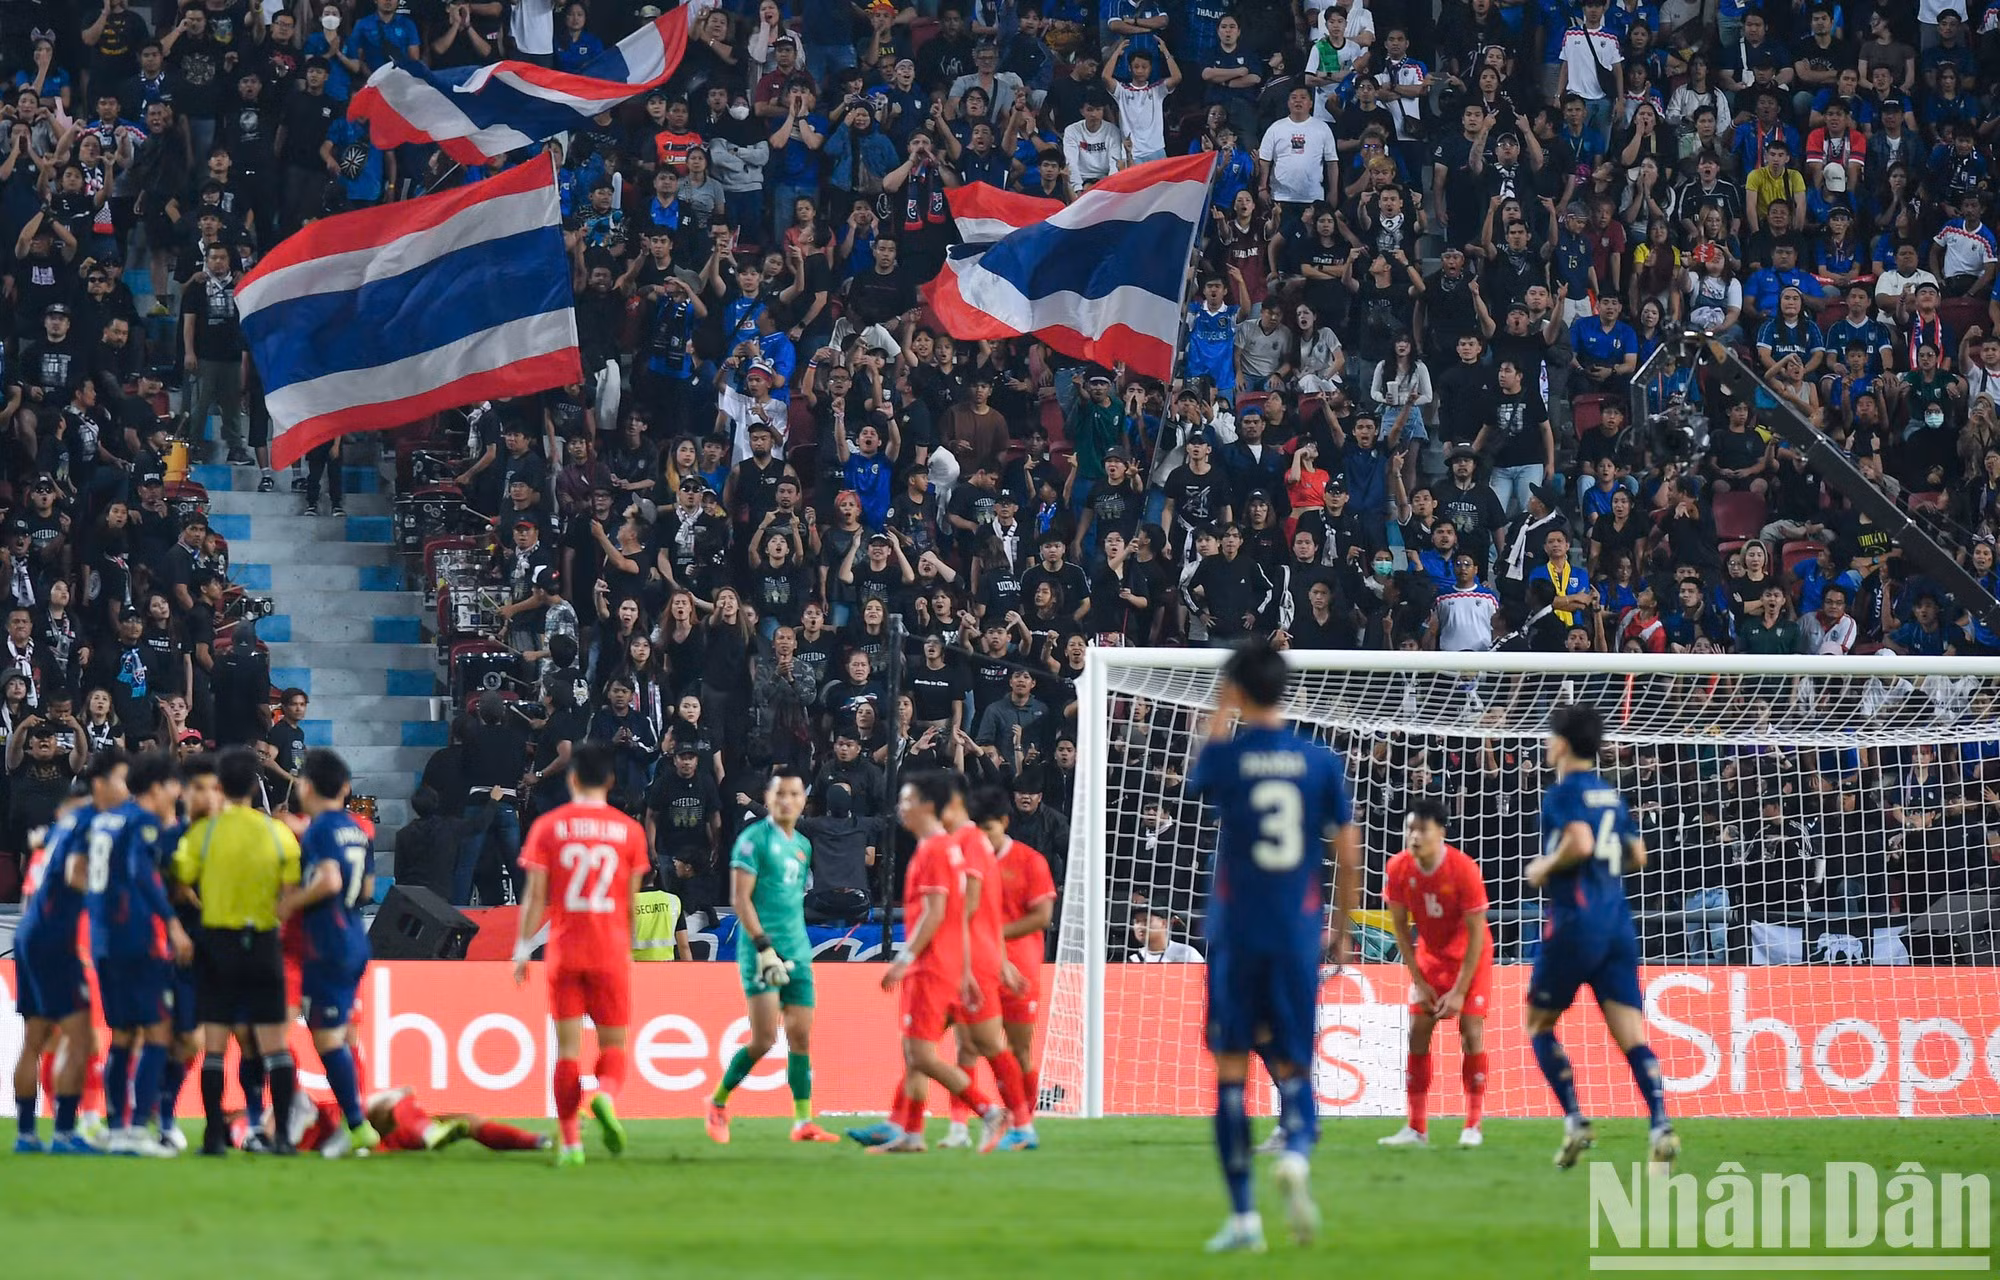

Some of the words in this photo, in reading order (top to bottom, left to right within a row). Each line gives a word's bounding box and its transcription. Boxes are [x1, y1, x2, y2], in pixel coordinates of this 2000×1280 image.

[1249, 779, 1304, 871] 3
[1594, 809, 1622, 877] 4
[344, 845, 368, 908] 7
[559, 842, 619, 913] 22
[635, 902, 670, 915] SECURITY
[1645, 971, 2000, 1117] Shop
